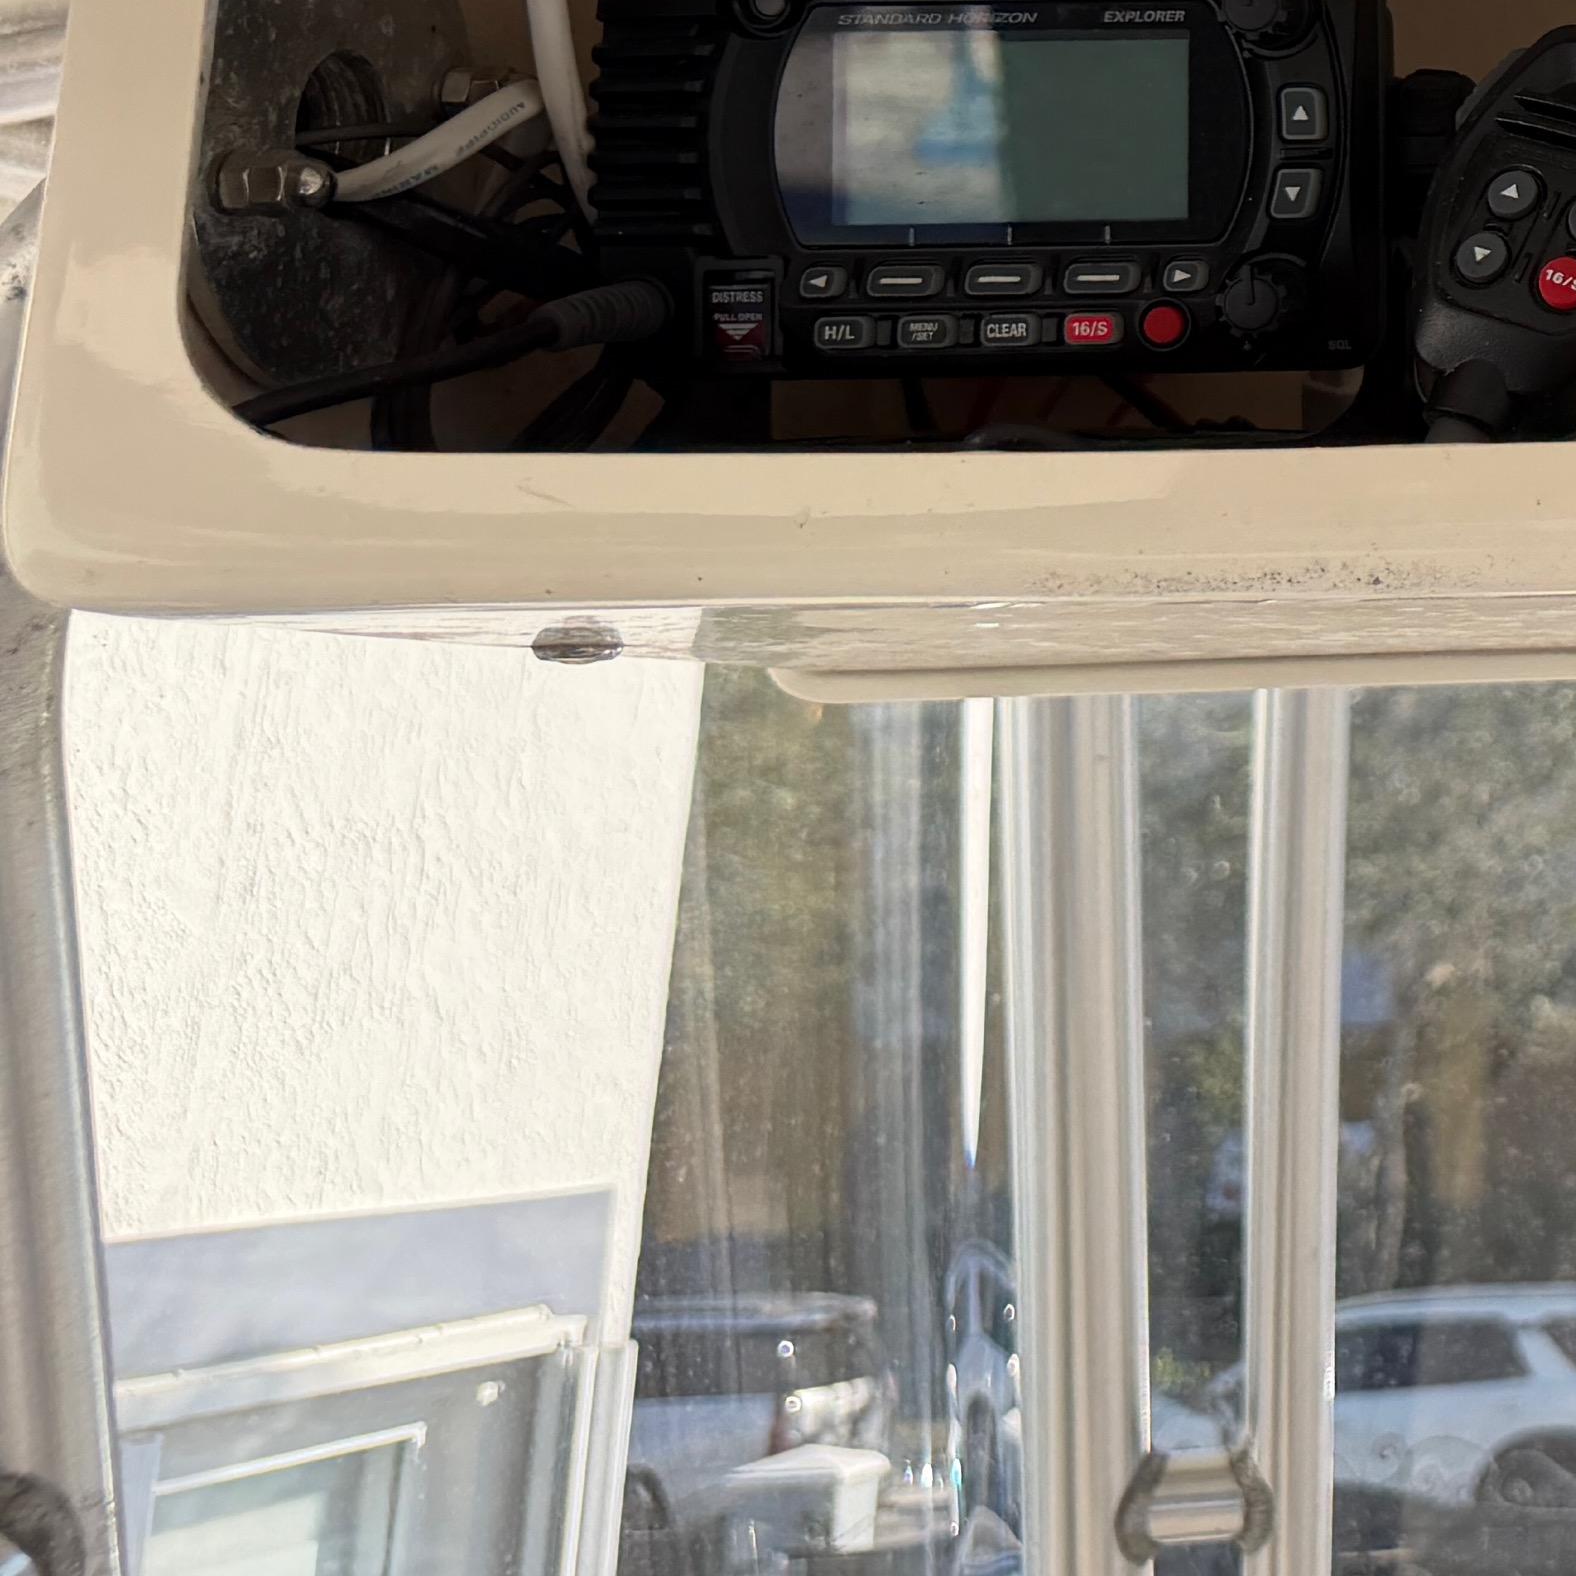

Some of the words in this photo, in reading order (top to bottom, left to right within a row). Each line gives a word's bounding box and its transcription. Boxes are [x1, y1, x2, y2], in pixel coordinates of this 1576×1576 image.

[838, 12, 943, 25] STANDARD
[947, 12, 1039, 24] HORIZON
[1103, 9, 1186, 24] EXPLORER
[711, 290, 764, 303] DISTRESS
[712, 312, 737, 322] PULL
[737, 312, 763, 322] OPEN
[824, 325, 855, 340] H/L
[986, 322, 1027, 338] CLEAR
[1071, 320, 1109, 336] 16/S
